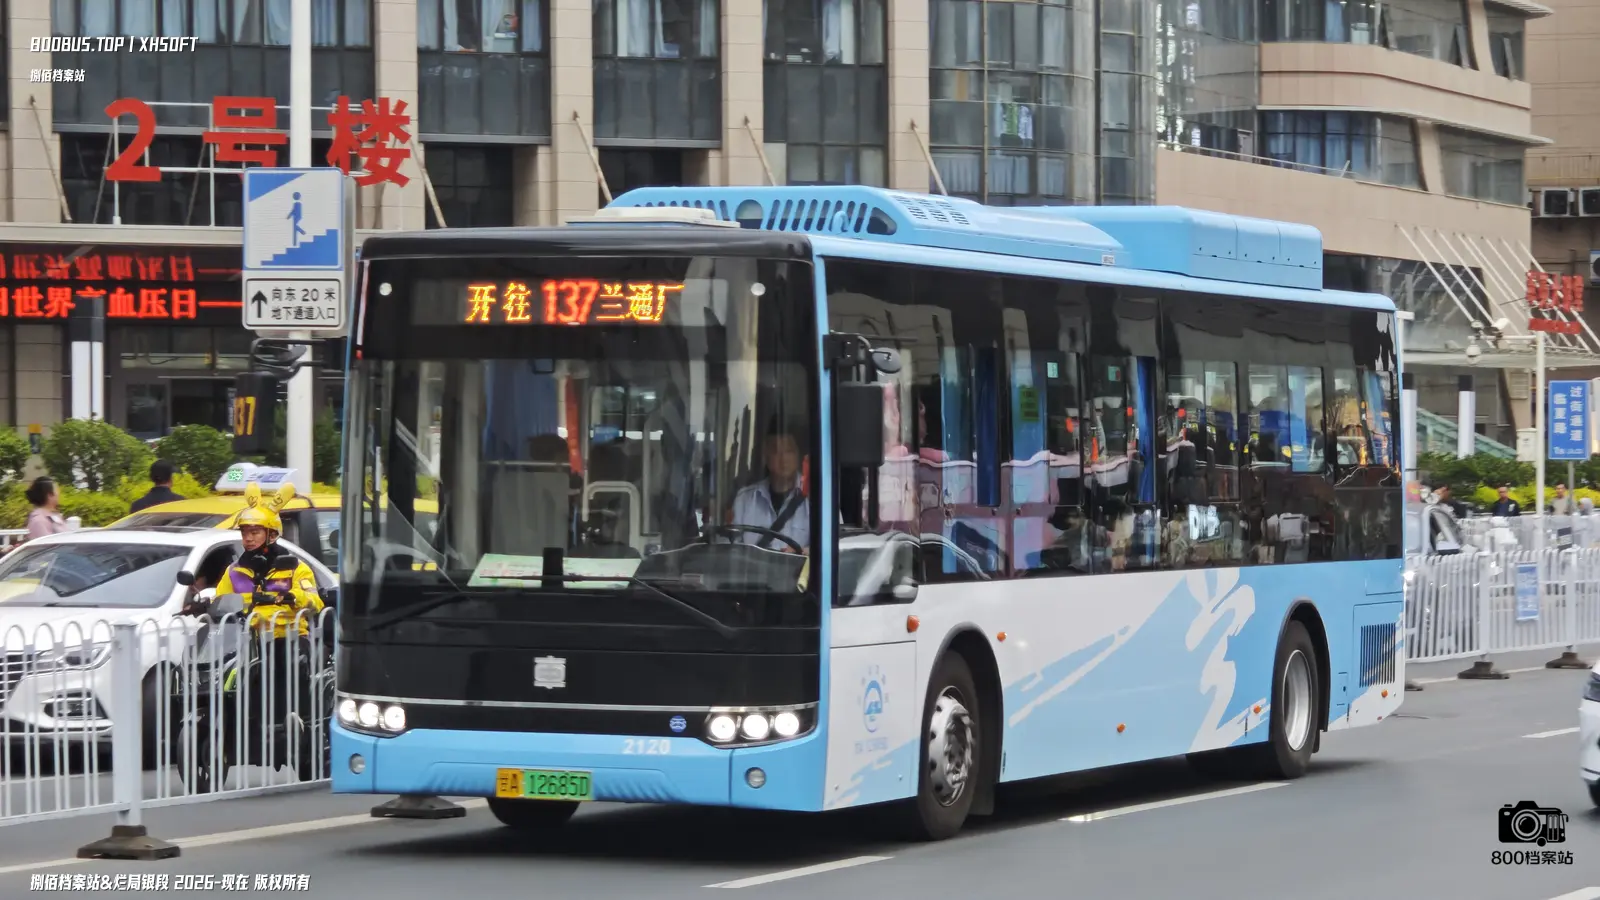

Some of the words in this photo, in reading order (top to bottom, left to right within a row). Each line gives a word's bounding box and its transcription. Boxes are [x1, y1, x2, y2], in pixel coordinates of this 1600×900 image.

[465, 282, 531, 322] 开往
[541, 279, 600, 323] 137
[596, 283, 685, 322] 兰通厂
[271, 306, 336, 321] 地下通道入口
[622, 739, 671, 755] 2120
